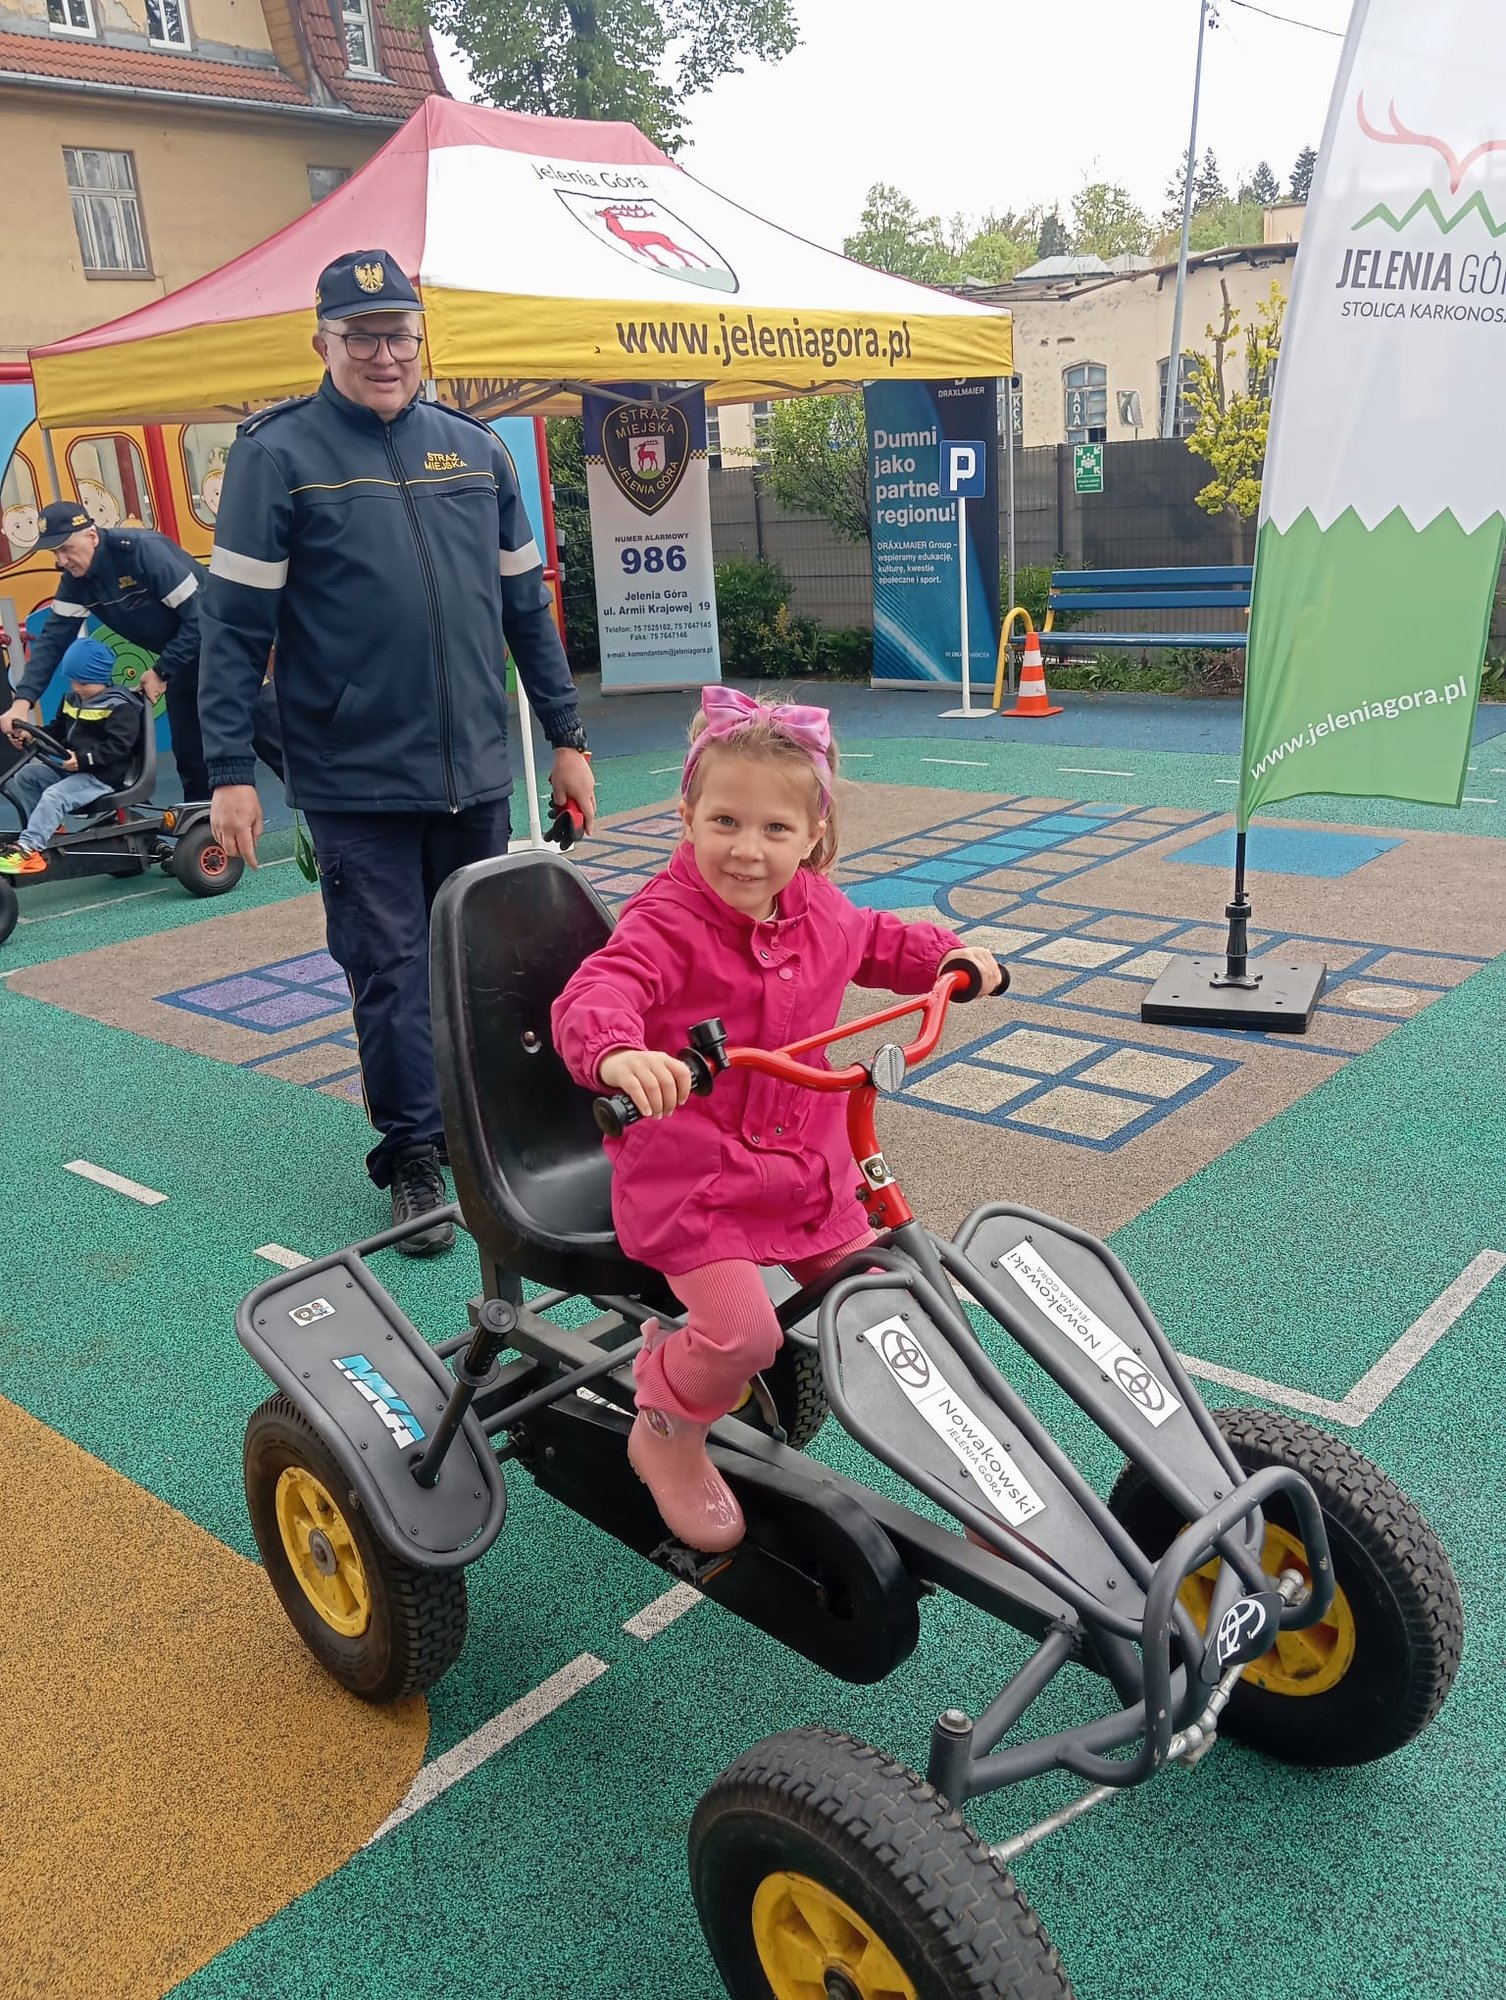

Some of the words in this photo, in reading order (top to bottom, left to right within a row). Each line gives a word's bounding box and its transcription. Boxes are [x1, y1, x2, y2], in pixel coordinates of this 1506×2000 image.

[531, 162, 600, 187] Jelenia
[600, 172, 649, 188] Góra
[1335, 249, 1452, 291] JELENIA
[1459, 250, 1506, 294] GÓ
[1341, 301, 1405, 318] STOLICA
[1410, 303, 1506, 323] KARKONOS
[616, 313, 913, 367] www.jeleniagora.pl
[619, 407, 670, 424] STRAŻ
[615, 422, 675, 440] MIEJSKA
[873, 426, 937, 450] Dumni
[424, 460, 469, 471] MIEJSKA
[426, 452, 459, 462] STRAŻ
[874, 454, 916, 478] jako
[950, 447, 976, 491] P
[618, 465, 656, 495] JELENIA
[656, 461, 680, 490] GÓRA
[876, 480, 939, 503] partne
[876, 502, 956, 527] regionu!
[614, 535, 643, 543] NUMER
[644, 532, 690, 542] ALARMOWY
[928, 541, 952, 551] Group
[620, 545, 687, 575] 986
[625, 590, 661, 601] Jelenia
[663, 588, 688, 599] Góra
[603, 608, 617, 617] ul.
[618, 605, 646, 616] Armii
[648, 602, 693, 614] Krajowej
[698, 601, 711, 611] 19
[1249, 675, 1468, 781] www.jeleniagora.pl
[1007, 1252, 1101, 1350] Nowakowski
[1060, 1292, 1091, 1323] JELENIA
[939, 1399, 1035, 1515] Nowakowski
[946, 1427, 980, 1465] JELENIA
[978, 1465, 1002, 1498] GÓRA
